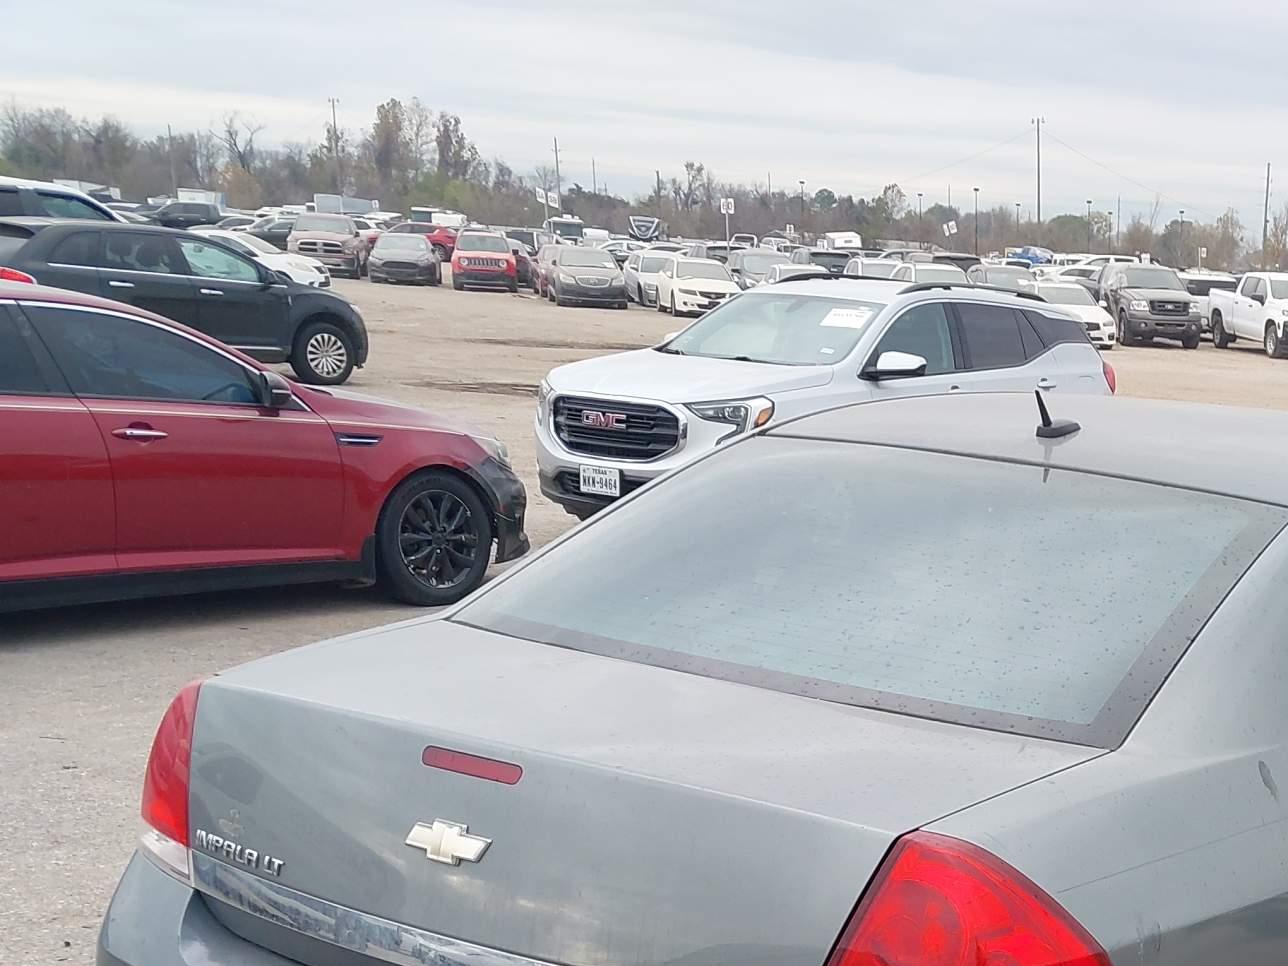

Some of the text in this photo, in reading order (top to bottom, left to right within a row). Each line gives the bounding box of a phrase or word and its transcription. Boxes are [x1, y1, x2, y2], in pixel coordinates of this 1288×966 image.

[582, 410, 627, 429] GMC
[196, 829, 284, 876] IMPALA LT
